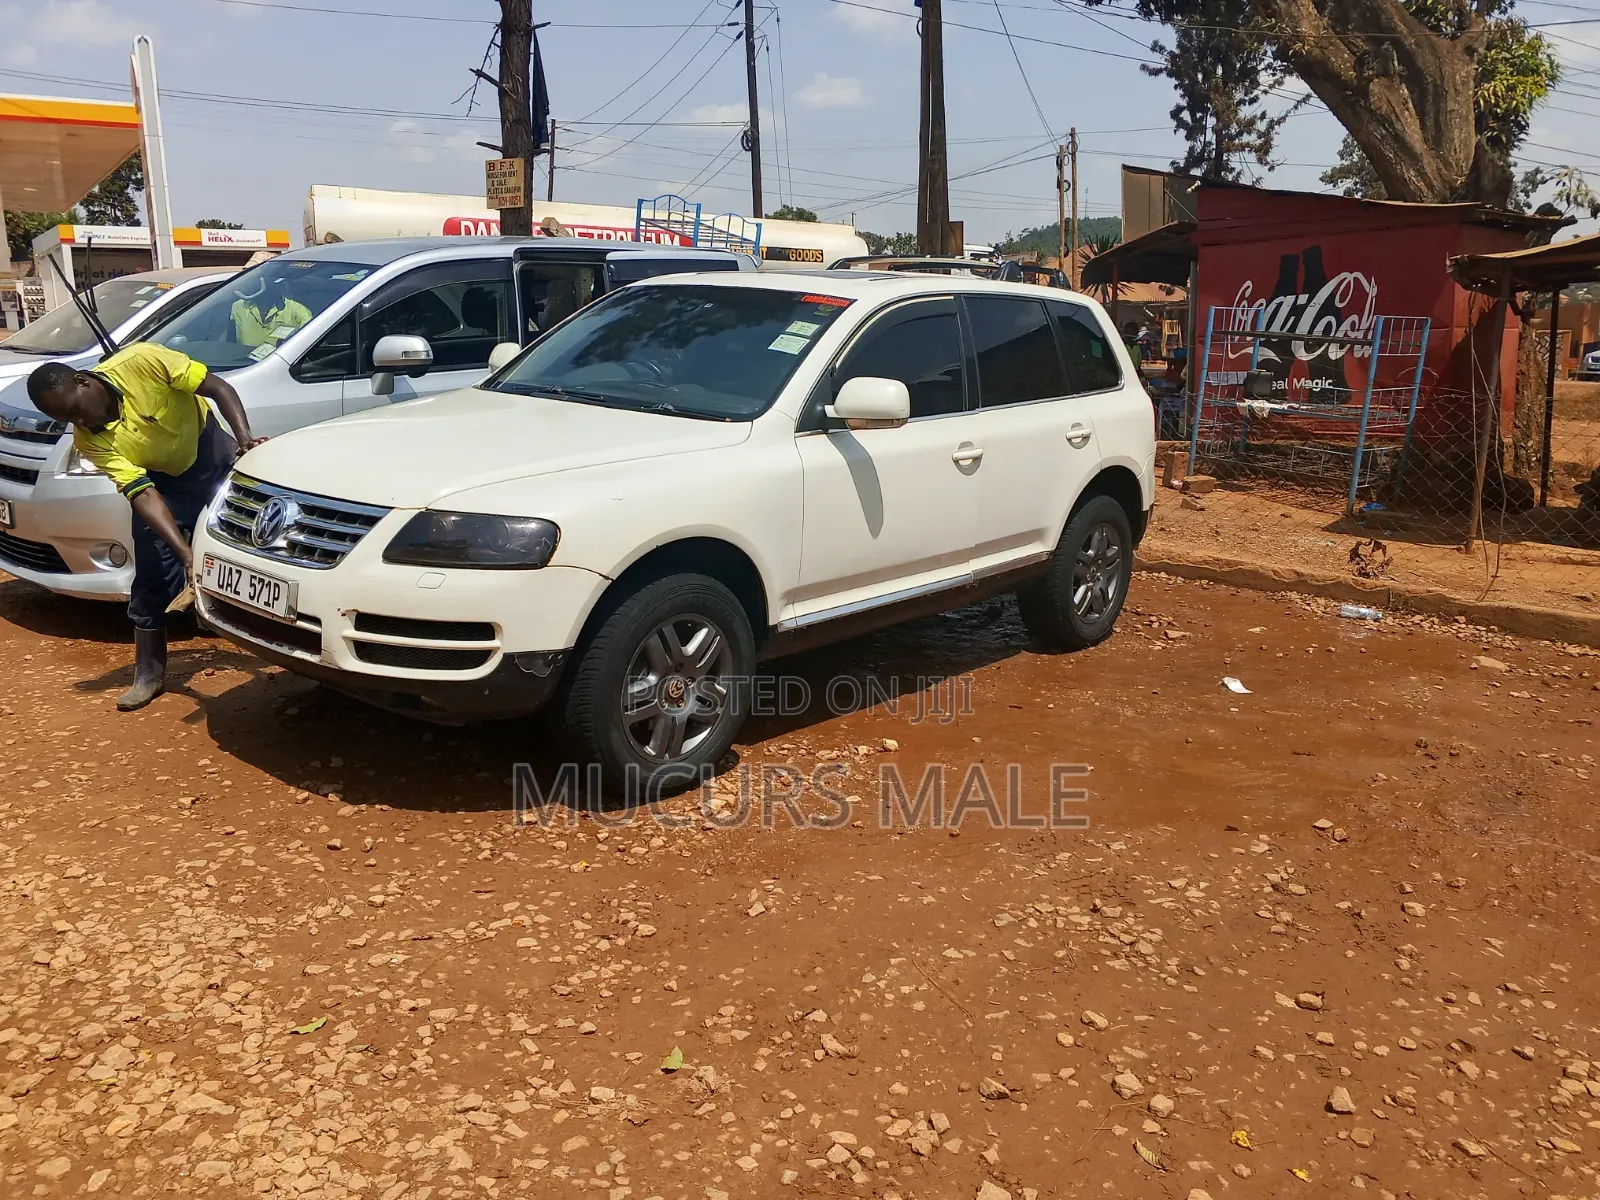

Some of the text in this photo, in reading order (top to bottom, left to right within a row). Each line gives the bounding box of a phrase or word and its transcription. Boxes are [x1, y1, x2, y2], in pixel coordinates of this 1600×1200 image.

[789, 248, 823, 262] GOODS
[1292, 376, 1334, 392] Magic
[217, 563, 280, 609] UAZ 571P
